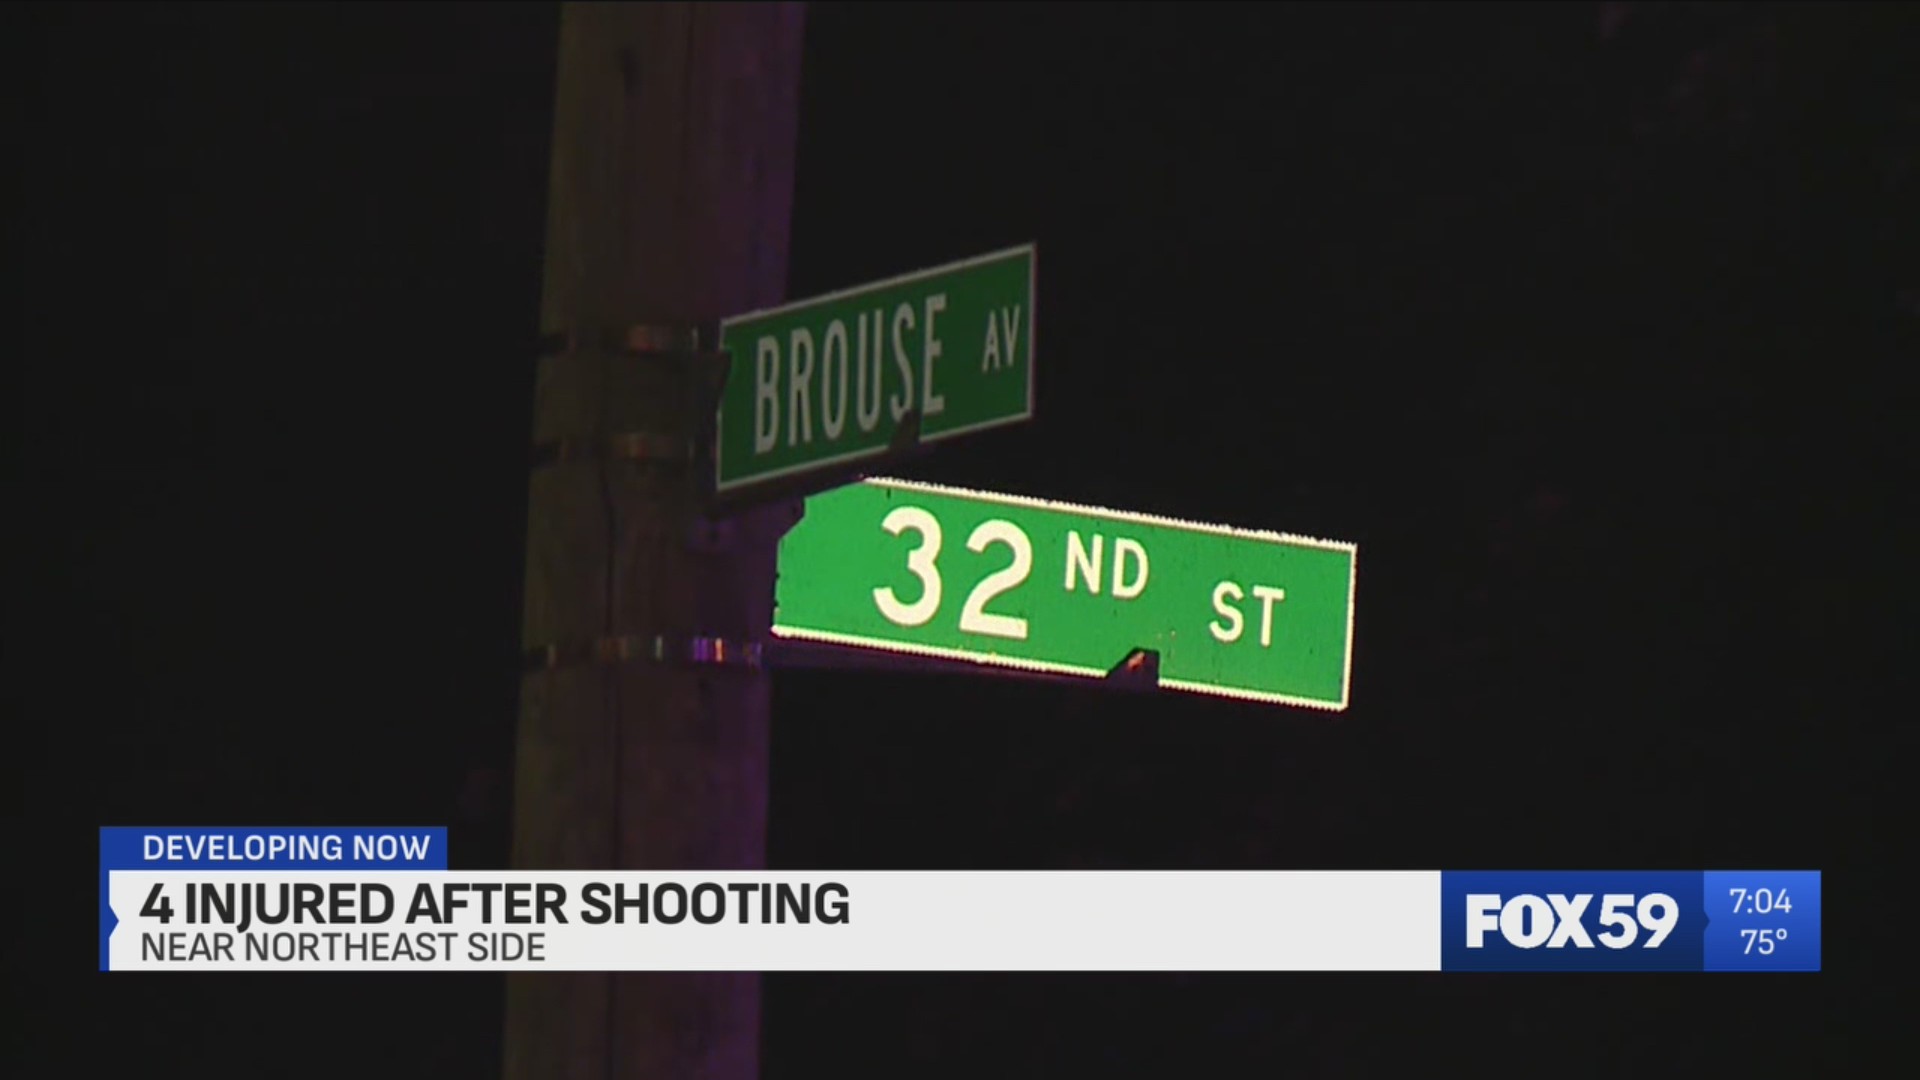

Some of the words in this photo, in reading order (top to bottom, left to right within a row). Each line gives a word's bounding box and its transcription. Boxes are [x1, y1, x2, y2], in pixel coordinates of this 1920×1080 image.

[754, 293, 947, 454] BROUSE
[982, 305, 1021, 373] AV
[1208, 580, 1286, 647] ST
